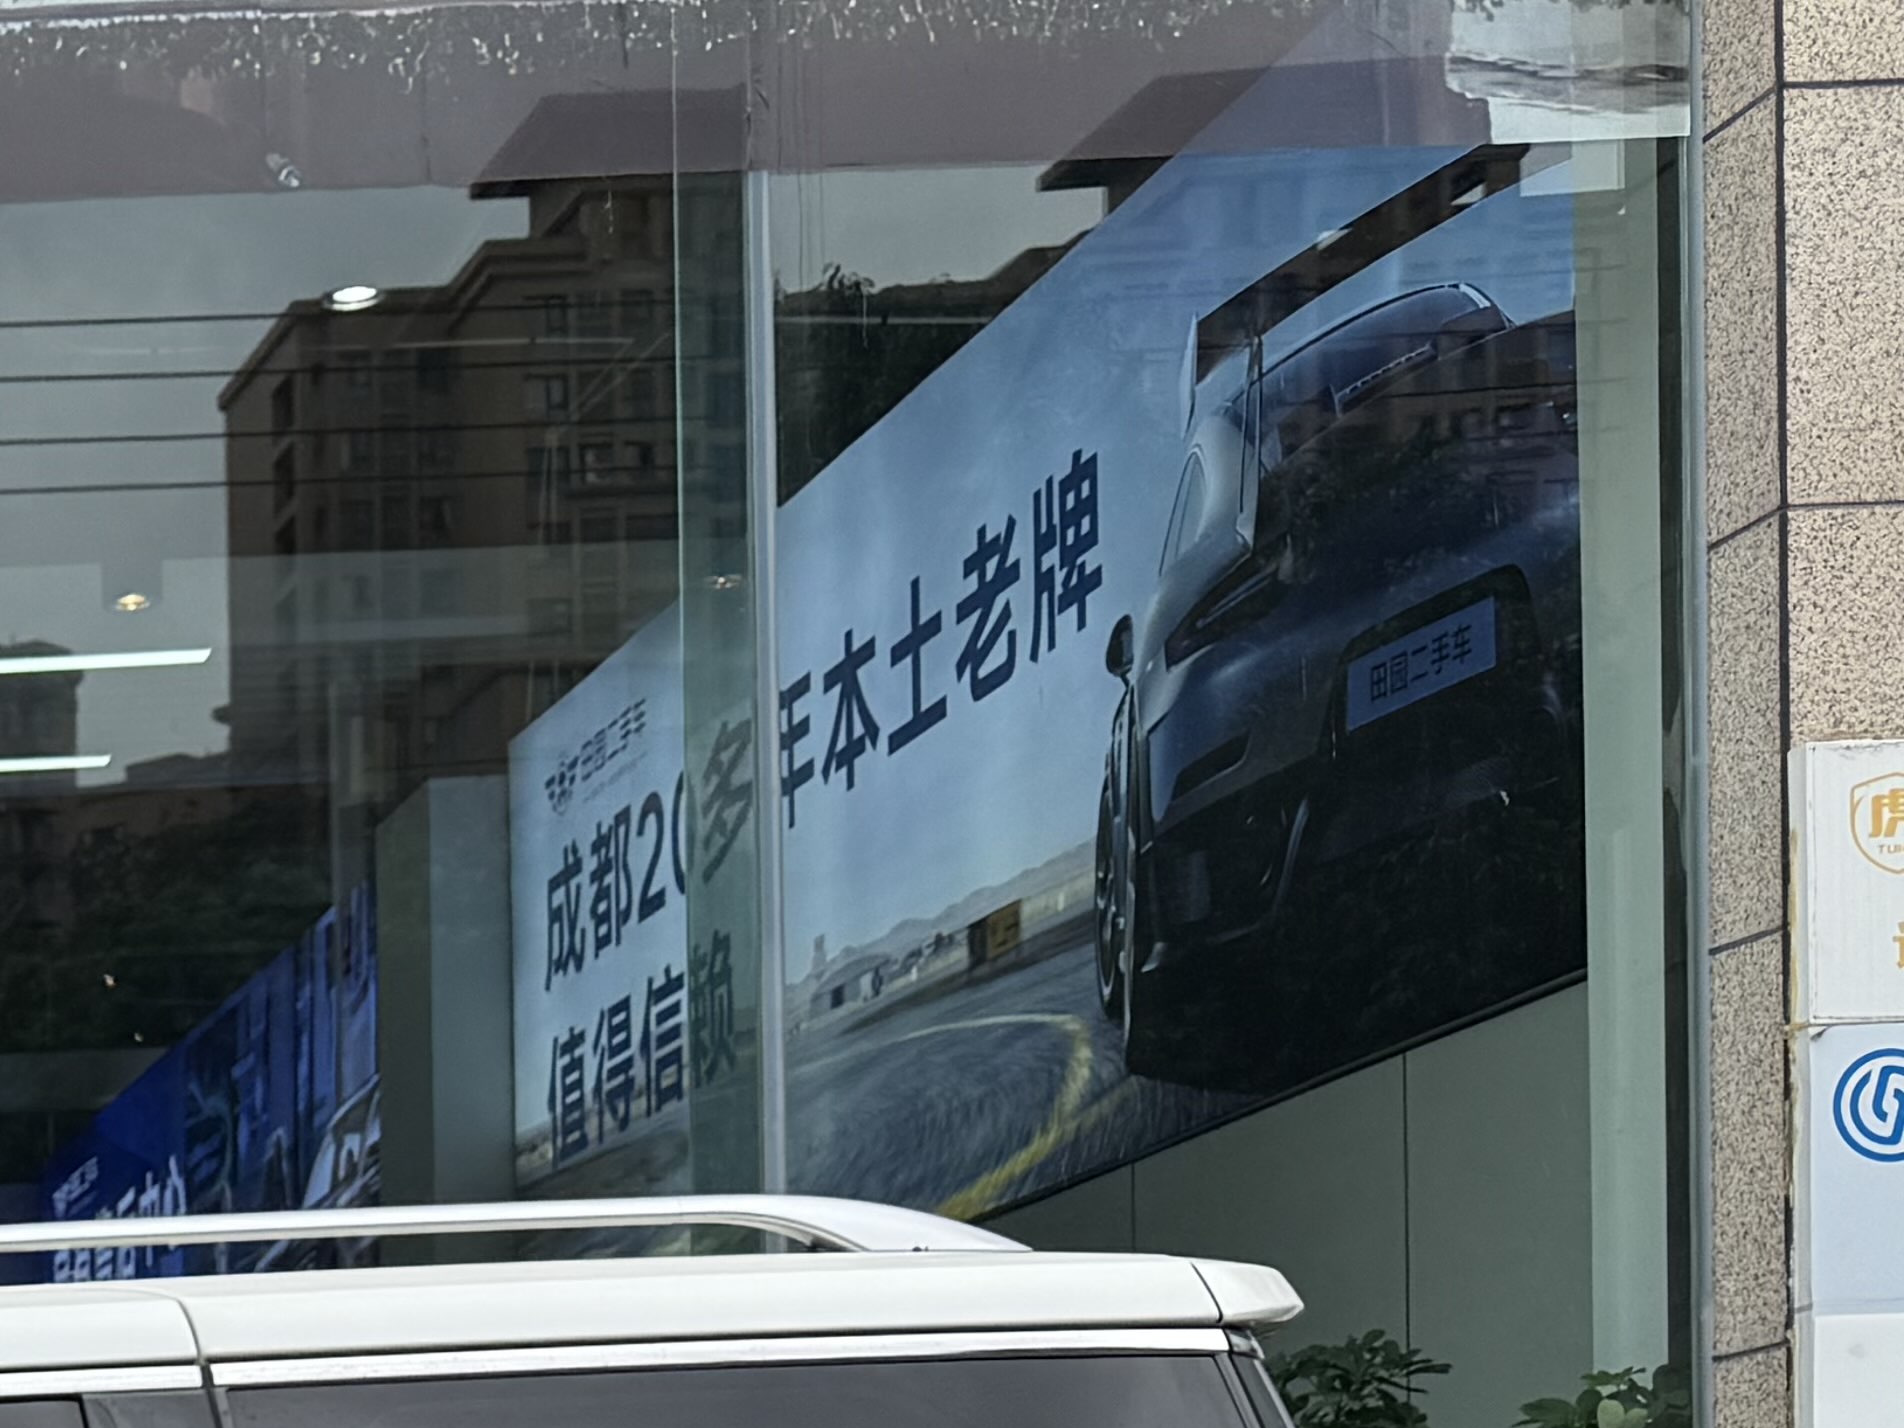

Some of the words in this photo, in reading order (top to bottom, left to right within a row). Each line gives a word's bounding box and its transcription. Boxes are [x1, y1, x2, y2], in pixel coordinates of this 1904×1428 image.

[1370, 623, 1474, 702] 田园二手车
[546, 928, 738, 1172] 值得信赖
